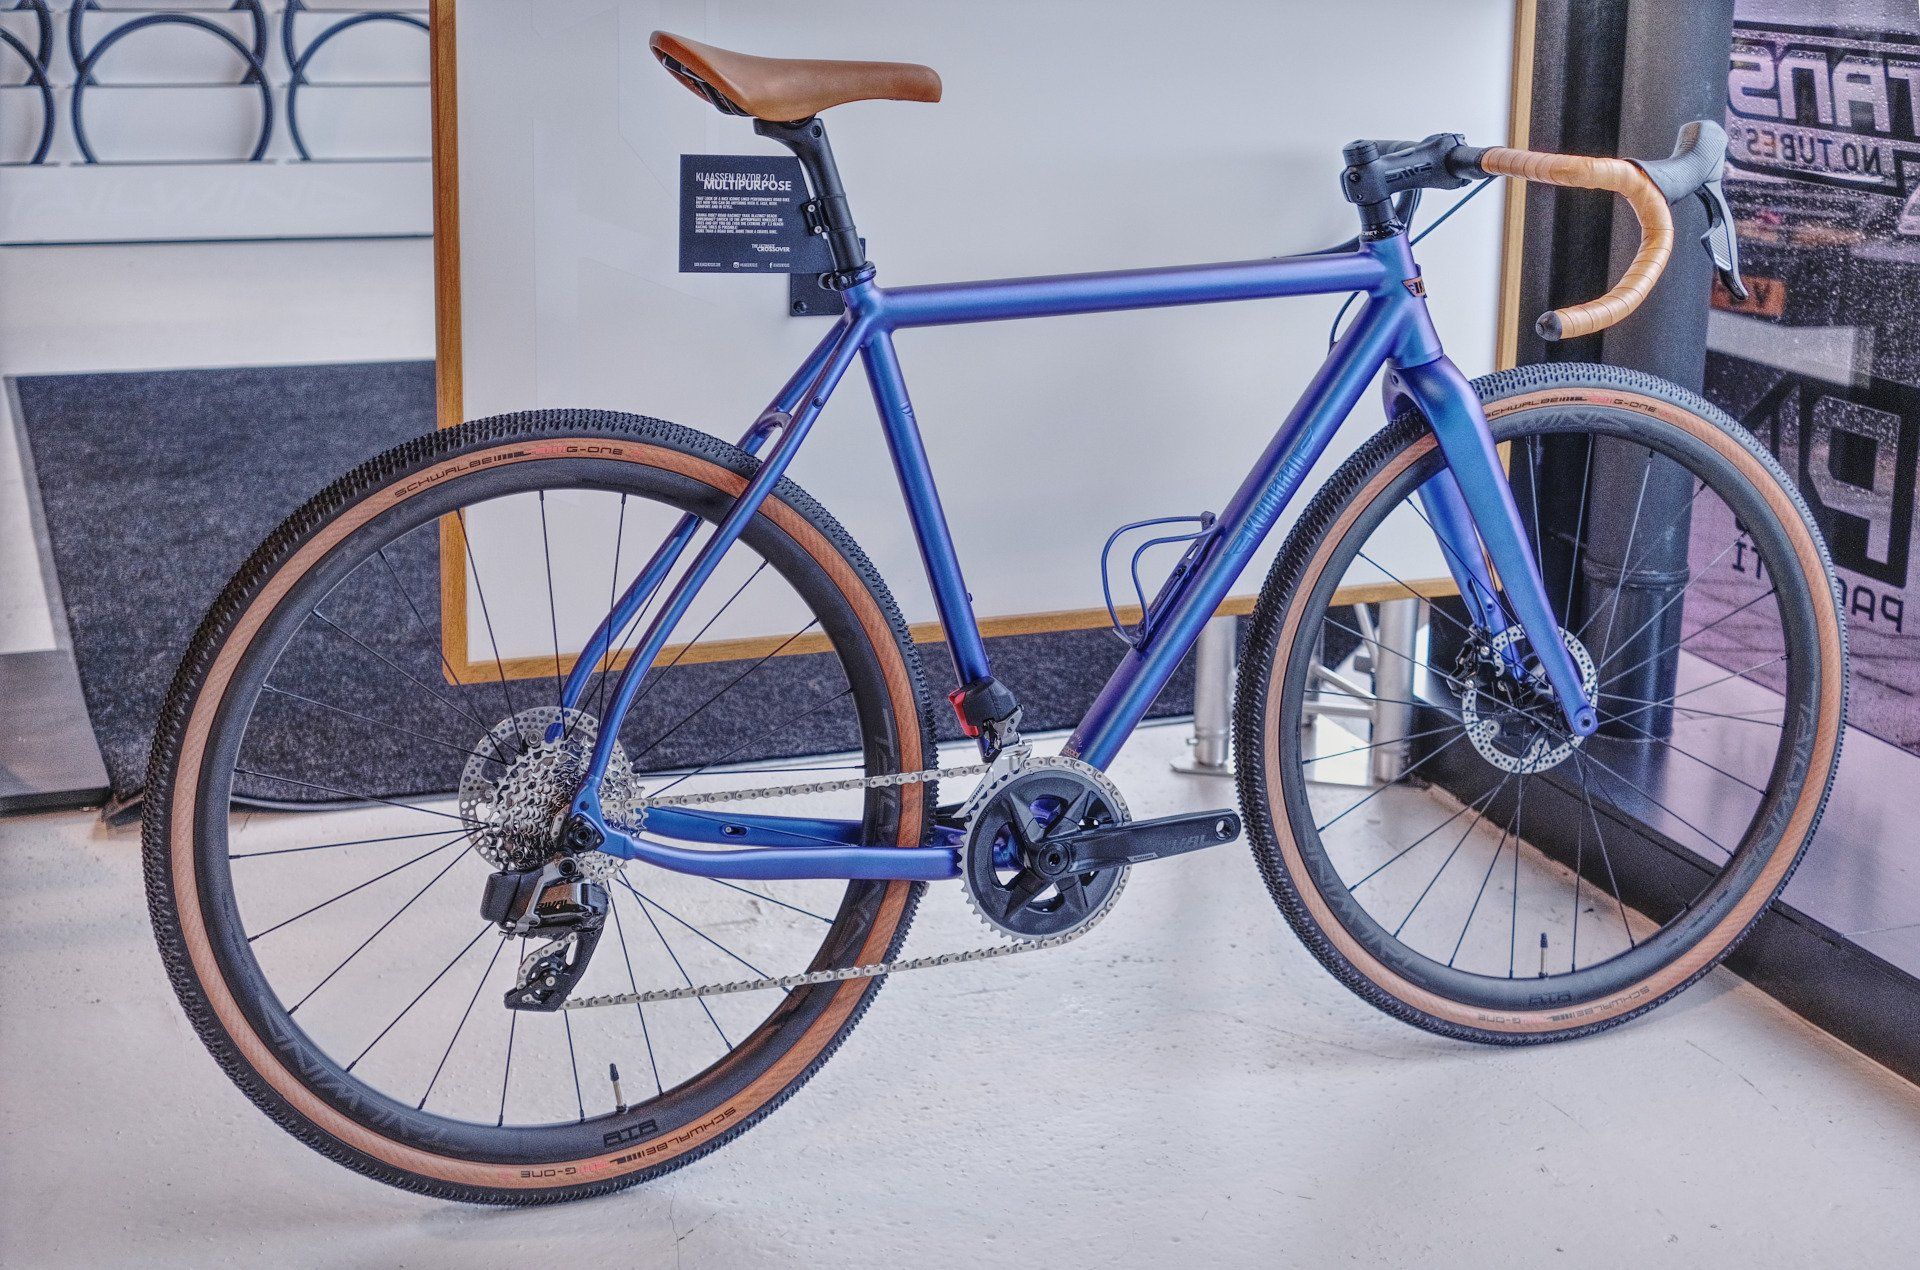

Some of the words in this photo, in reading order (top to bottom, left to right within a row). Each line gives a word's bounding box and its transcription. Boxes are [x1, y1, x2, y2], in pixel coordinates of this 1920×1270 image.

[696, 172, 734, 181] KLAASSEN
[736, 173, 761, 182] RAZOR
[703, 180, 792, 191] MULTIPURPOSE
[394, 456, 493, 498] SCHWALBE
[1576, 985, 1650, 1017] SCHWALBE
[646, 1106, 736, 1154] SCHWALBE
